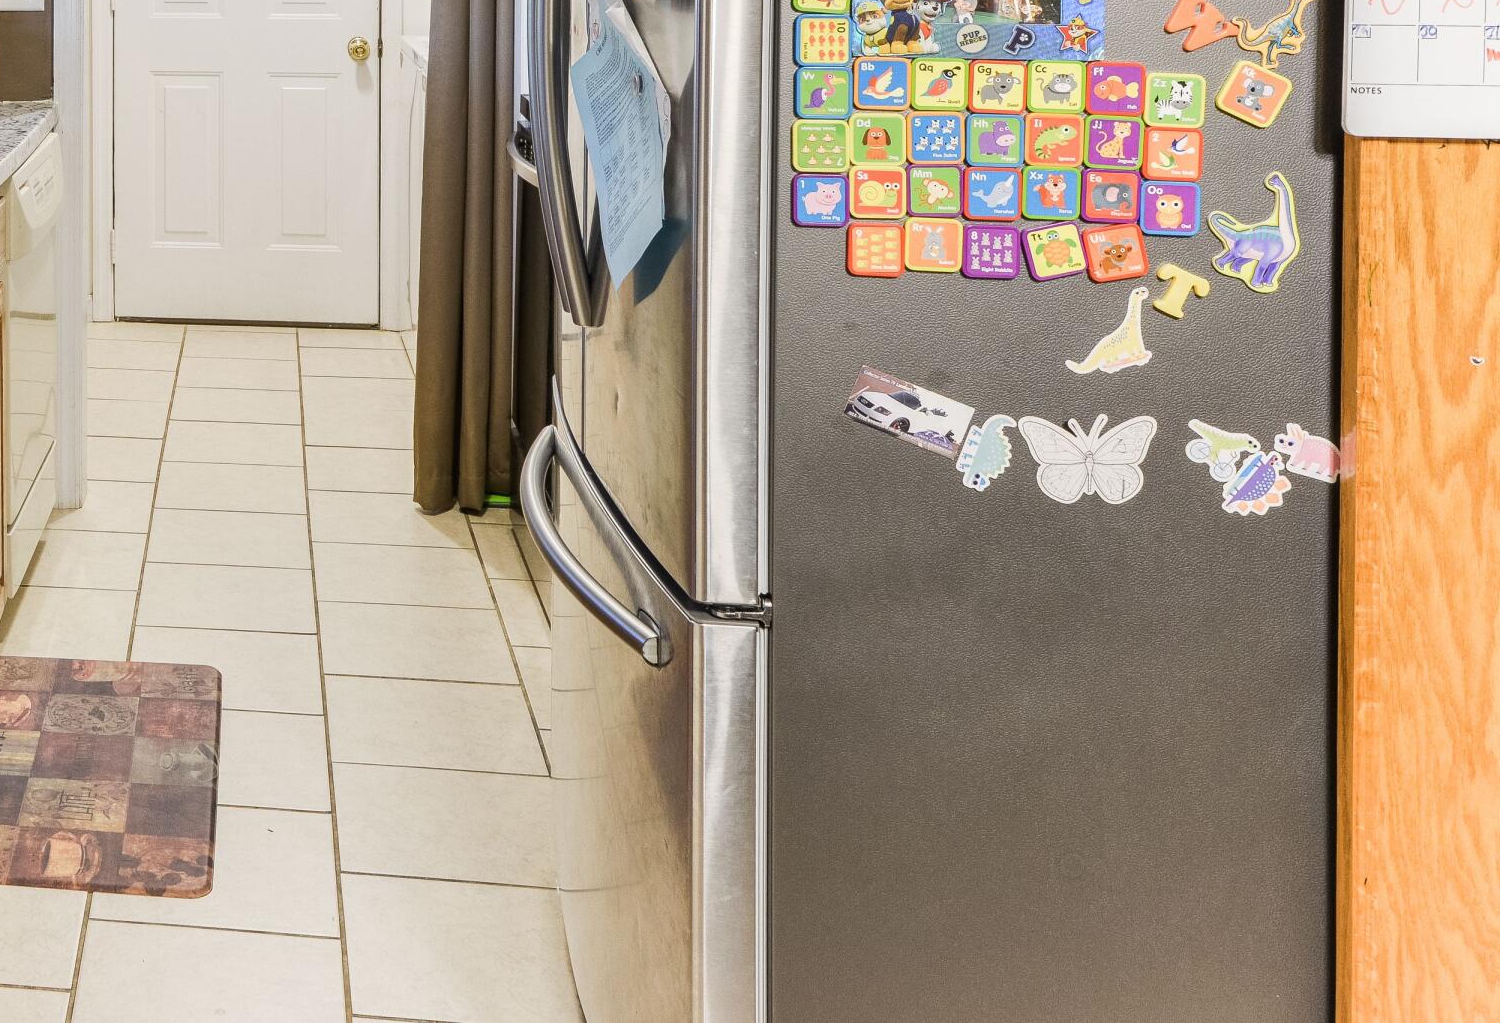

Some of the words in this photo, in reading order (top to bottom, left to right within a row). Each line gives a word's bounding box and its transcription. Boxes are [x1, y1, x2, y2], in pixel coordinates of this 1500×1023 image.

[962, 30, 980, 40] PUP
[1003, 25, 1036, 55] P
[861, 63, 875, 71] Bb
[919, 64, 934, 73] Qq
[977, 66, 992, 75] Gg
[1035, 65, 1047, 73] Cc
[1093, 67, 1104, 76] Ff
[1351, 87, 1382, 95] NOTES
[856, 119, 871, 128] Dd
[973, 119, 988, 128] Hh
[856, 171, 868, 179] Ss
[913, 170, 932, 178] Mm
[971, 173, 987, 181] Nn
[1029, 171, 1043, 180] Xx
[1147, 186, 1163, 195] Oo
[971, 231, 978, 240] 8
[1031, 233, 1043, 241] Tt
[1153, 263, 1210, 319] T
